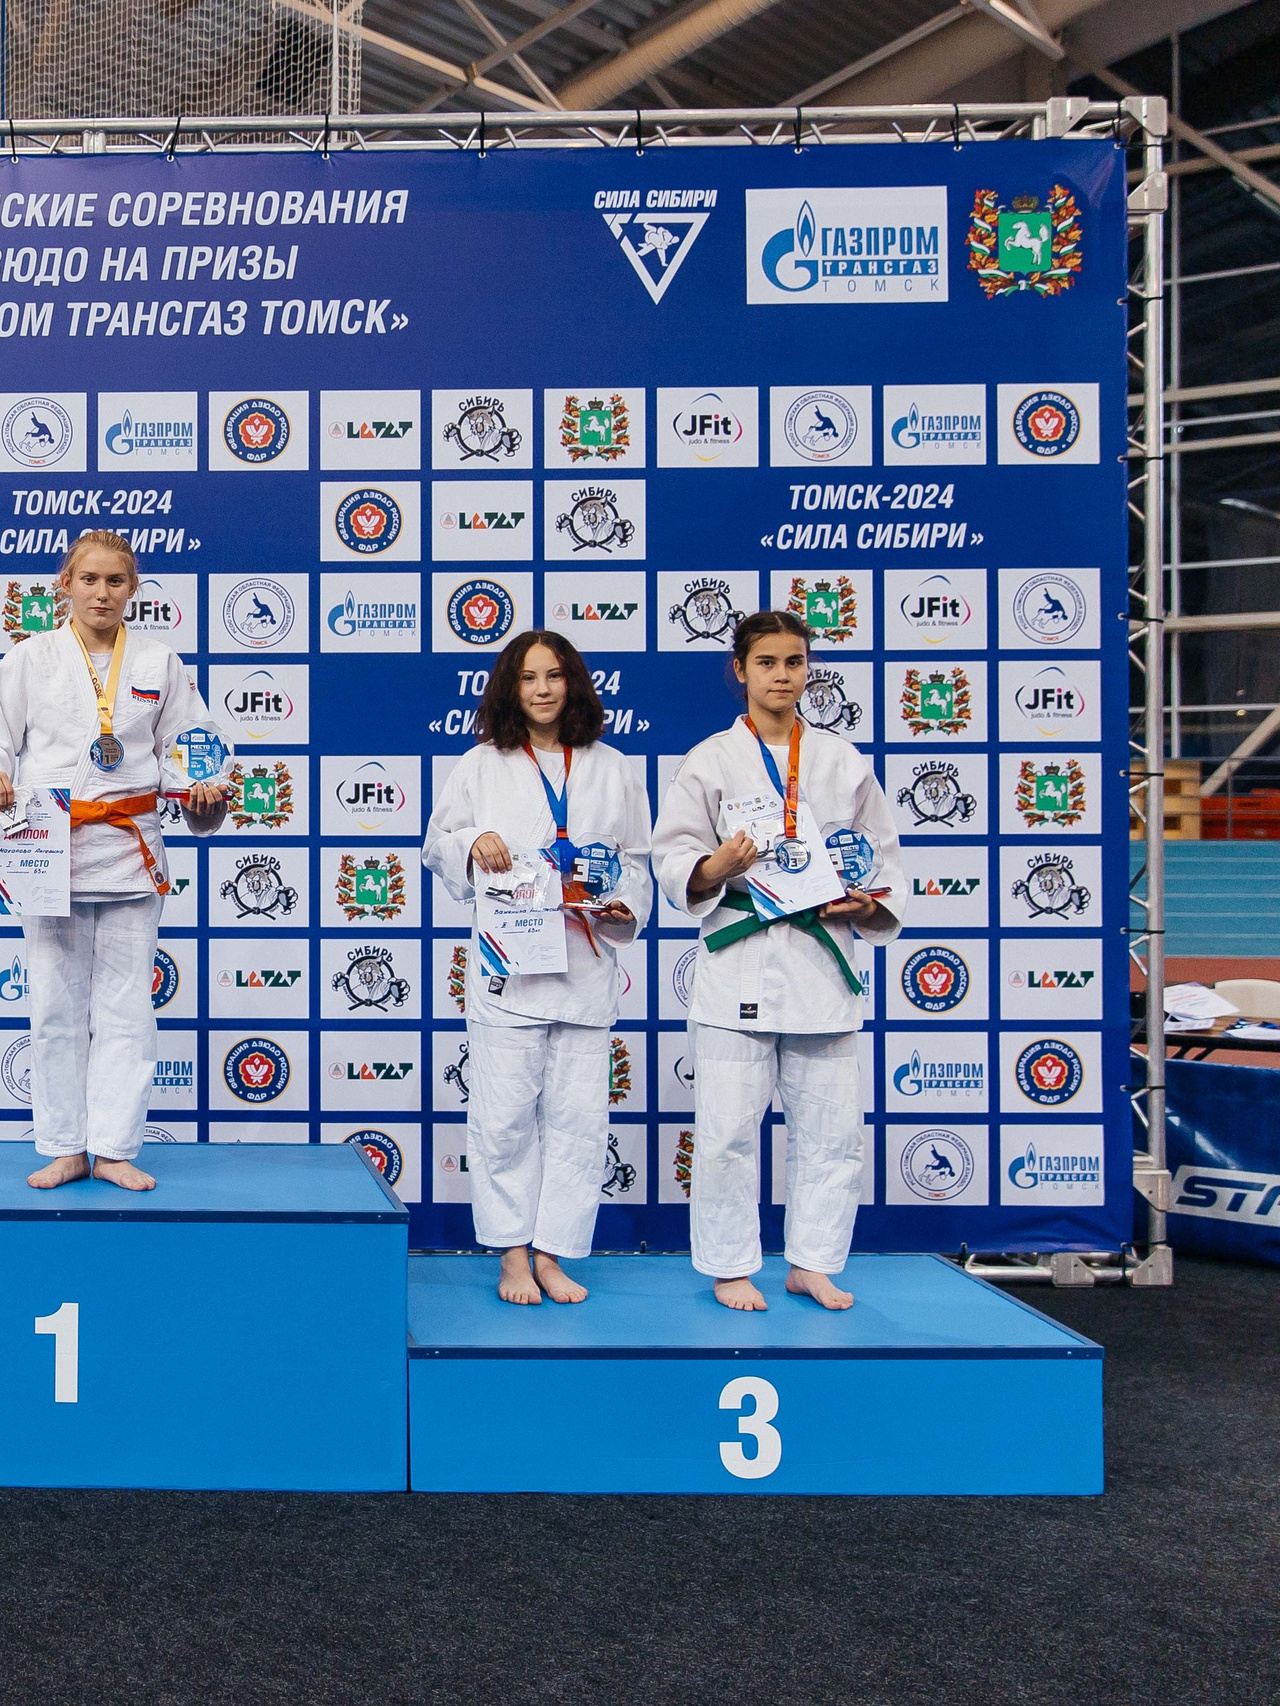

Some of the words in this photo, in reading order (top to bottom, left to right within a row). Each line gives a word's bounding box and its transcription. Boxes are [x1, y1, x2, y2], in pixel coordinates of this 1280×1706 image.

[594, 190, 640, 209] СИЛА
[646, 189, 718, 208] СИБИРИ
[107, 189, 409, 227] СОРЕВНОВАНИЯ
[822, 226, 939, 256] ГАЗПРОМ
[99, 246, 148, 281] НА
[161, 245, 299, 281] ПРИЗЫ
[823, 260, 938, 275] ТРАНСГАЗ
[822, 279, 939, 293] ТОМСК
[67, 300, 248, 337] ТРАНСГАЗ
[261, 299, 409, 335] ТОМСК»
[458, 395, 504, 412] СИБИРЬ
[134, 422, 192, 437] ГАЗПРОМ
[682, 413, 731, 435] JFit
[921, 415, 980, 430] ГАЗПРОМ
[921, 432, 980, 440] ТРАНСГАЗ
[12, 489, 173, 516] ТОМСК-2024
[571, 486, 617, 503] СИБИРЬ
[789, 484, 955, 511] ТОМСК-2024
[760, 524, 848, 550] «СИЛА
[684, 577, 730, 594] СИБИРЬ
[357, 603, 415, 618] ГАЗПРОМ
[450, 584, 472, 630] ФЕДЕРАЦИЯ
[499, 599, 511, 631] РОССИИ
[909, 596, 959, 617] JFit
[470, 634, 490, 642] ФДР
[131, 694, 159, 706] RUSSIA
[233, 691, 282, 712] JFit
[1024, 688, 1073, 709] JFit
[912, 761, 958, 777] СИБИРЬ
[345, 782, 393, 804] JFit
[235, 854, 280, 871] СИБИРЬ
[573, 857, 589, 882] 3
[1026, 853, 1073, 869] СИБИРЬ
[347, 946, 392, 962] СИБИРЬ
[923, 1063, 983, 1077] ГАЗПРОМ
[1018, 1044, 1041, 1091] ФЕДЕРАЦИЯ
[1068, 1058, 1081, 1091] РОССИИ
[924, 1079, 983, 1087] ТРАНСГАЗ
[1039, 1094, 1059, 1102] ФДР
[1038, 1156, 1098, 1170] ГАЗПРОМ
[34, 1302, 78, 1403] 1
[719, 1376, 781, 1479] 3
